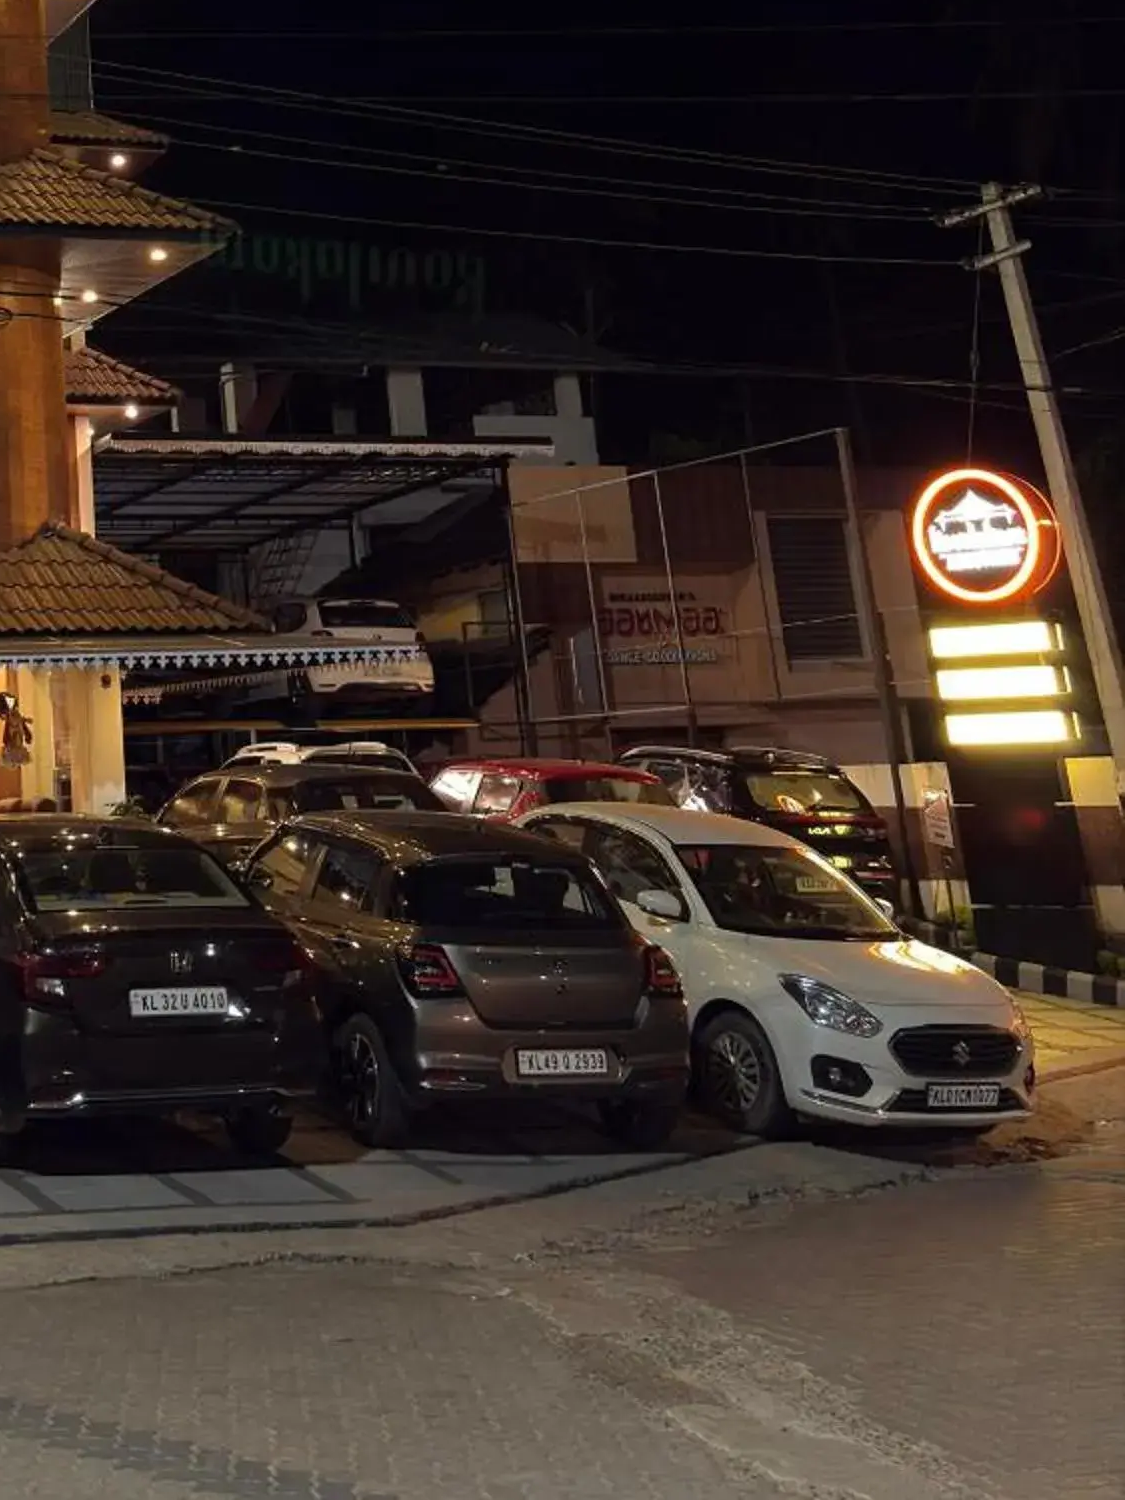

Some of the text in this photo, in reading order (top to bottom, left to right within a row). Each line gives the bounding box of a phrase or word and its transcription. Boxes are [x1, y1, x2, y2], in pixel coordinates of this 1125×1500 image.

[141, 995, 158, 1011] KL
[161, 993, 178, 1011] 32
[193, 991, 225, 1009] 4010
[528, 1053, 543, 1071] KL
